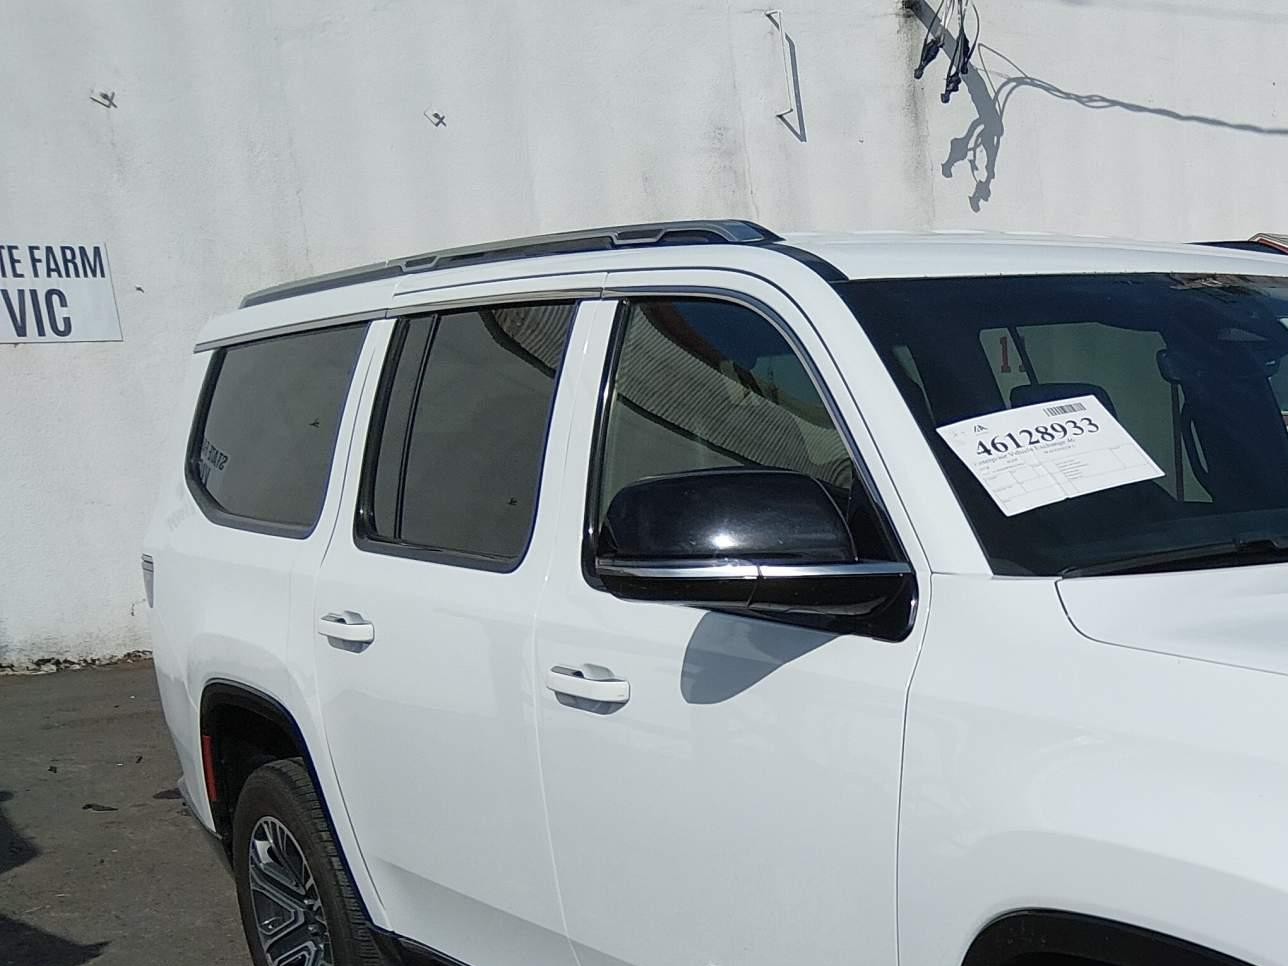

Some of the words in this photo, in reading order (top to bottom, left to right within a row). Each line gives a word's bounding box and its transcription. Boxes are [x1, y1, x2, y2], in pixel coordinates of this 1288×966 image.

[28, 245, 106, 279] FARM
[0, 288, 72, 338] VIC
[976, 417, 1100, 457] 46128933
